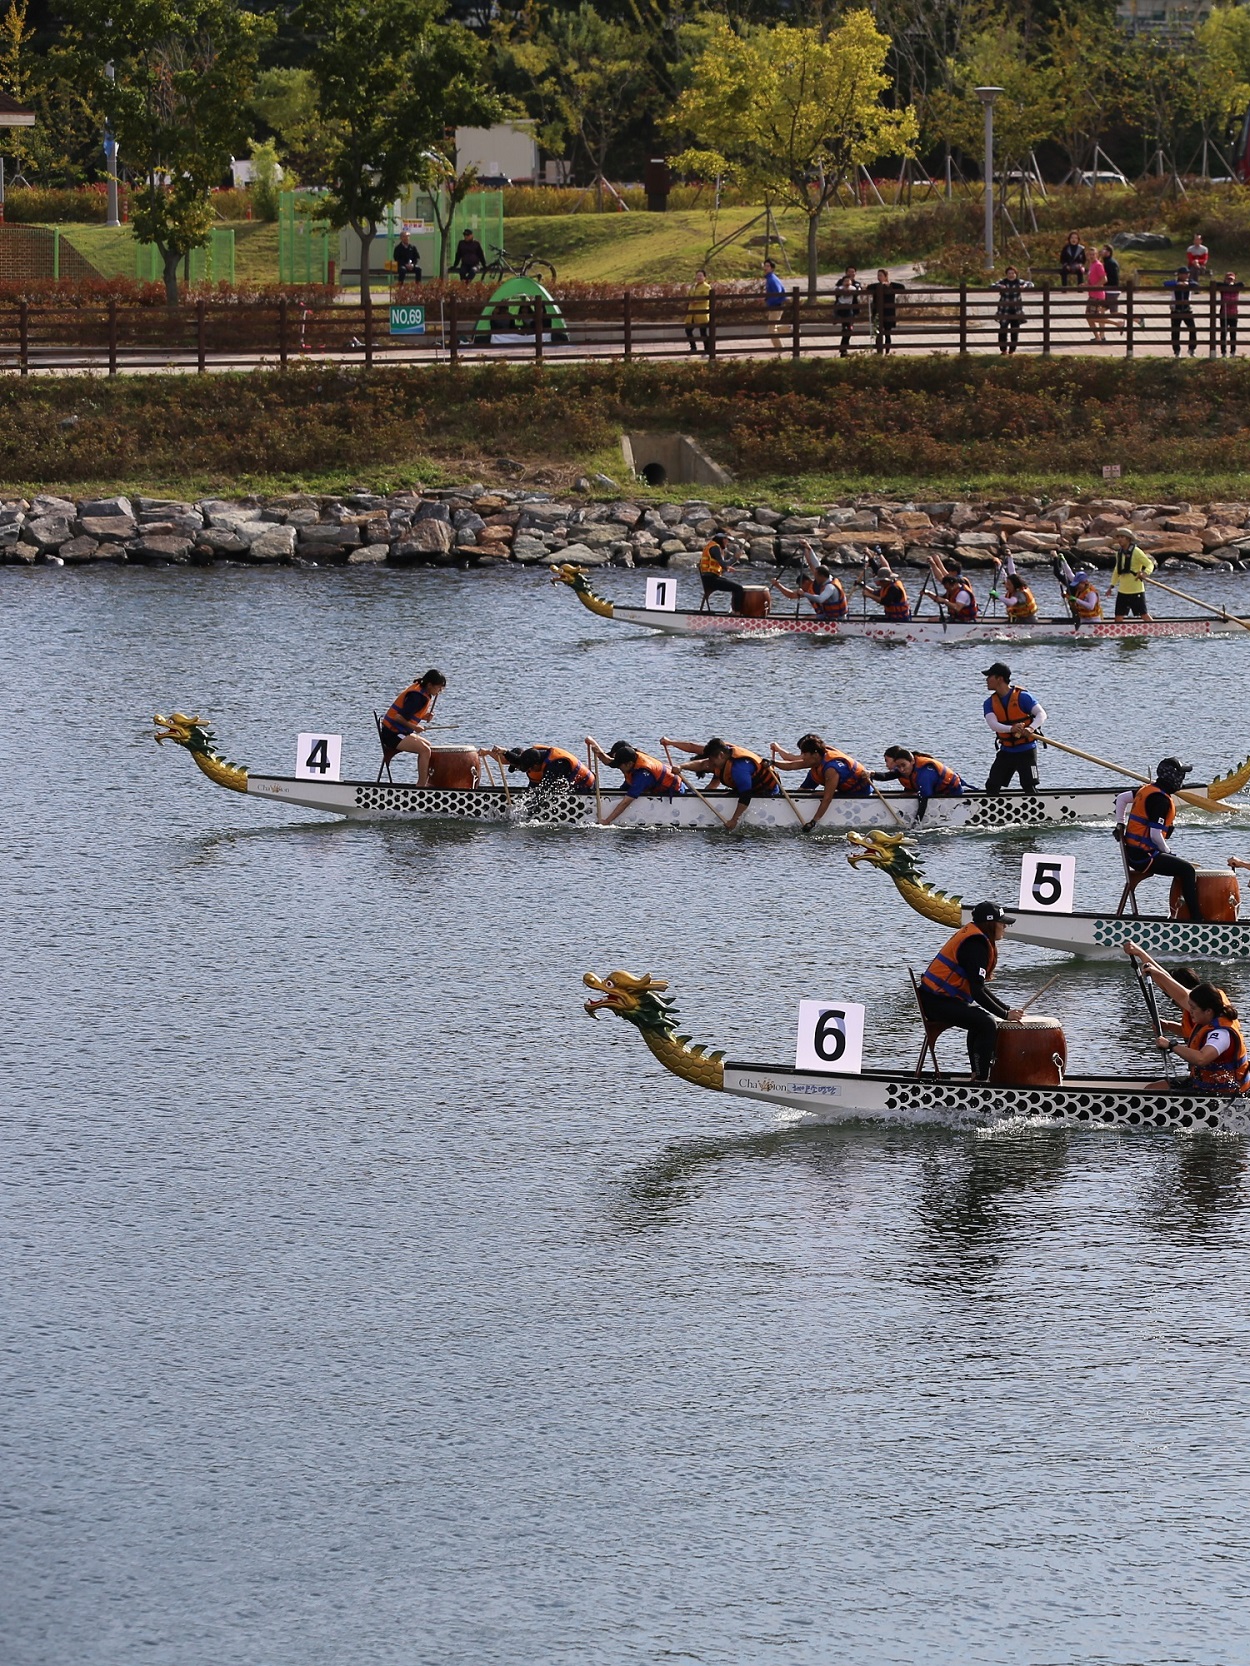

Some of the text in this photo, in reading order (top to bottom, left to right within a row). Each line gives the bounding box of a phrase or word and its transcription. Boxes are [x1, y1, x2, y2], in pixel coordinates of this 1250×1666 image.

[392, 308, 422, 325] NO.69
[657, 582, 666, 606] 1
[306, 739, 331, 774] 4
[1032, 862, 1062, 905] 5
[814, 1010, 846, 1061] 6
